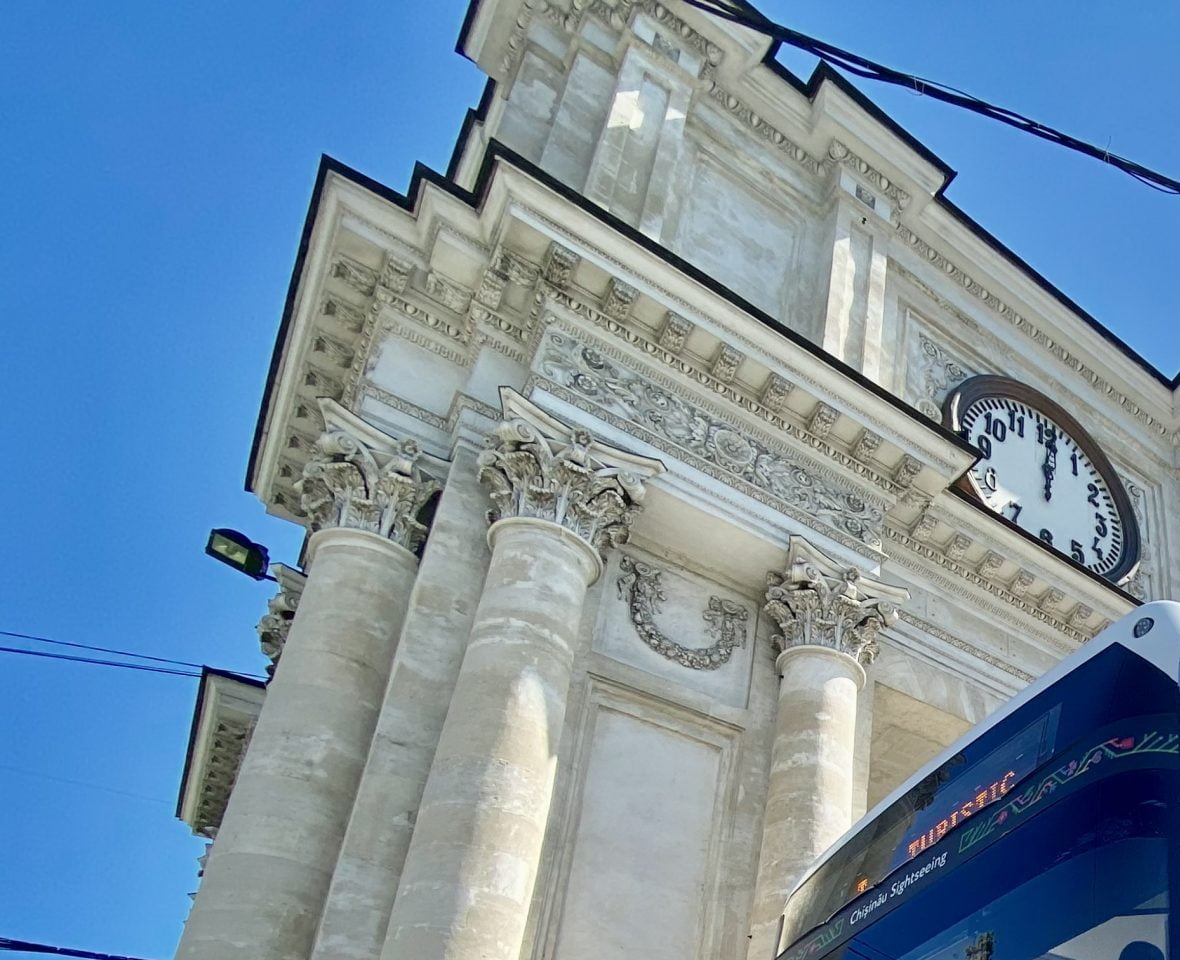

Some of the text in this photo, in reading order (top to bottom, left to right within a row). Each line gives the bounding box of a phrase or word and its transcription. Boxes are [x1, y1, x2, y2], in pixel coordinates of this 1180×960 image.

[984, 411, 1007, 443] 10
[1008, 409, 1025, 438] 11
[977, 434, 992, 460] 9
[1070, 452, 1079, 477] 1
[1087, 483, 1100, 508] 2
[1095, 511, 1108, 538] 3
[1071, 539, 1086, 565] 5
[889, 851, 949, 898] Sightseeing
